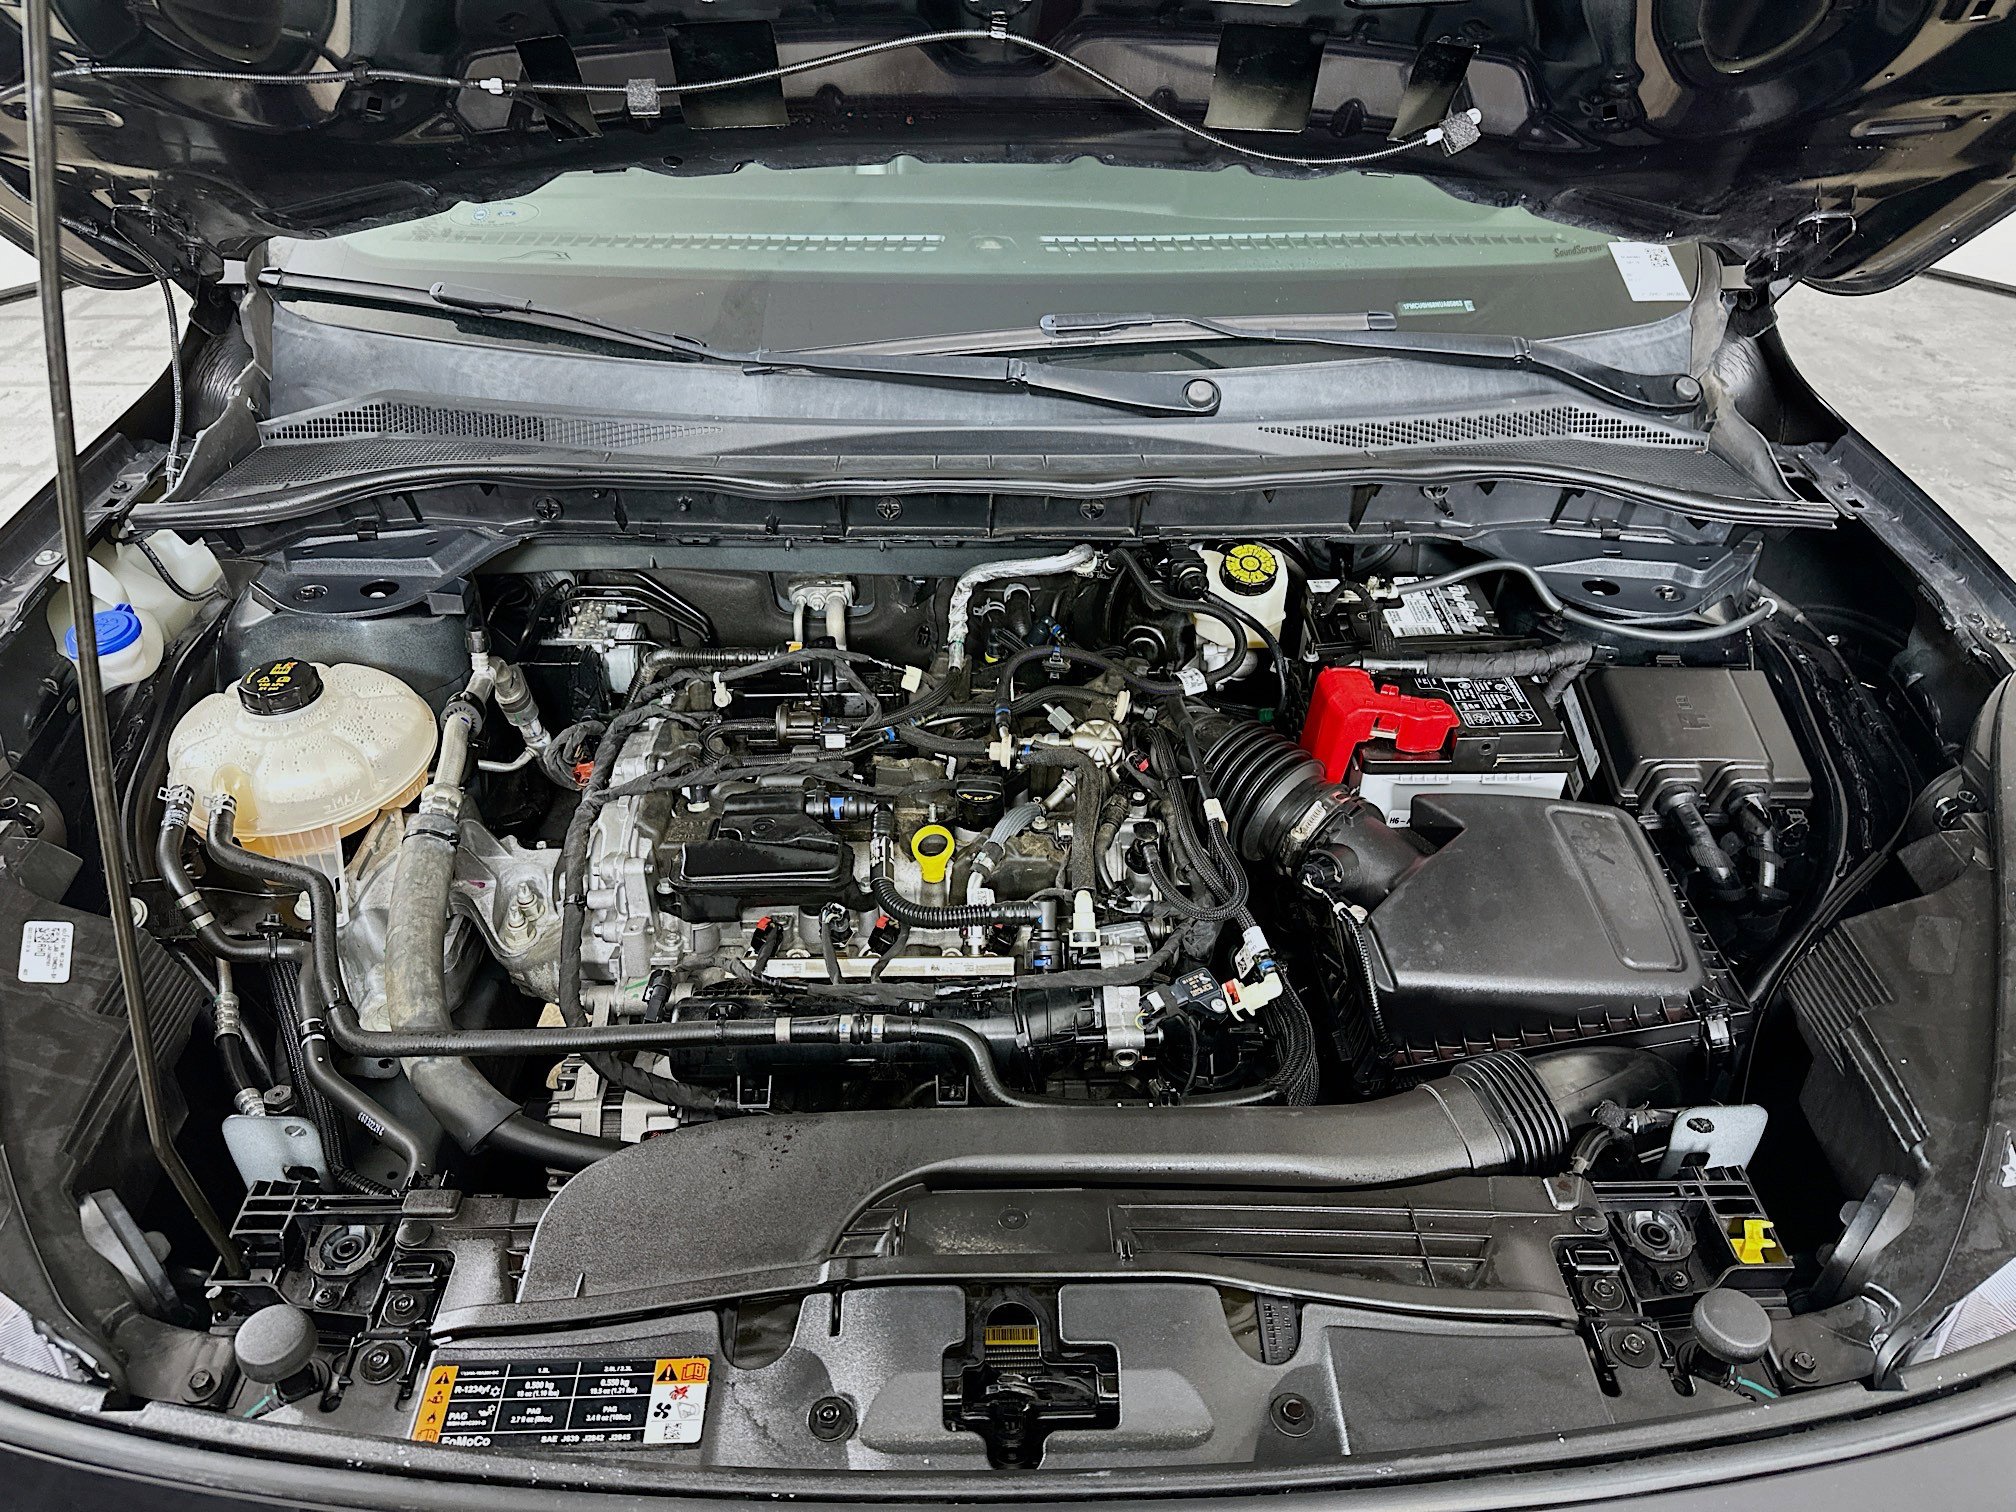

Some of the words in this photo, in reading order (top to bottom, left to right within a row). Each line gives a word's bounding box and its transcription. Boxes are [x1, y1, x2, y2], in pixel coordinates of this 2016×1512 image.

[454, 1384, 492, 1395] R-1234yf
[526, 1407, 541, 1415] PAG
[602, 1405, 618, 1413] PAG
[448, 1412, 469, 1420] PAG
[540, 1435, 559, 1443] SAE
